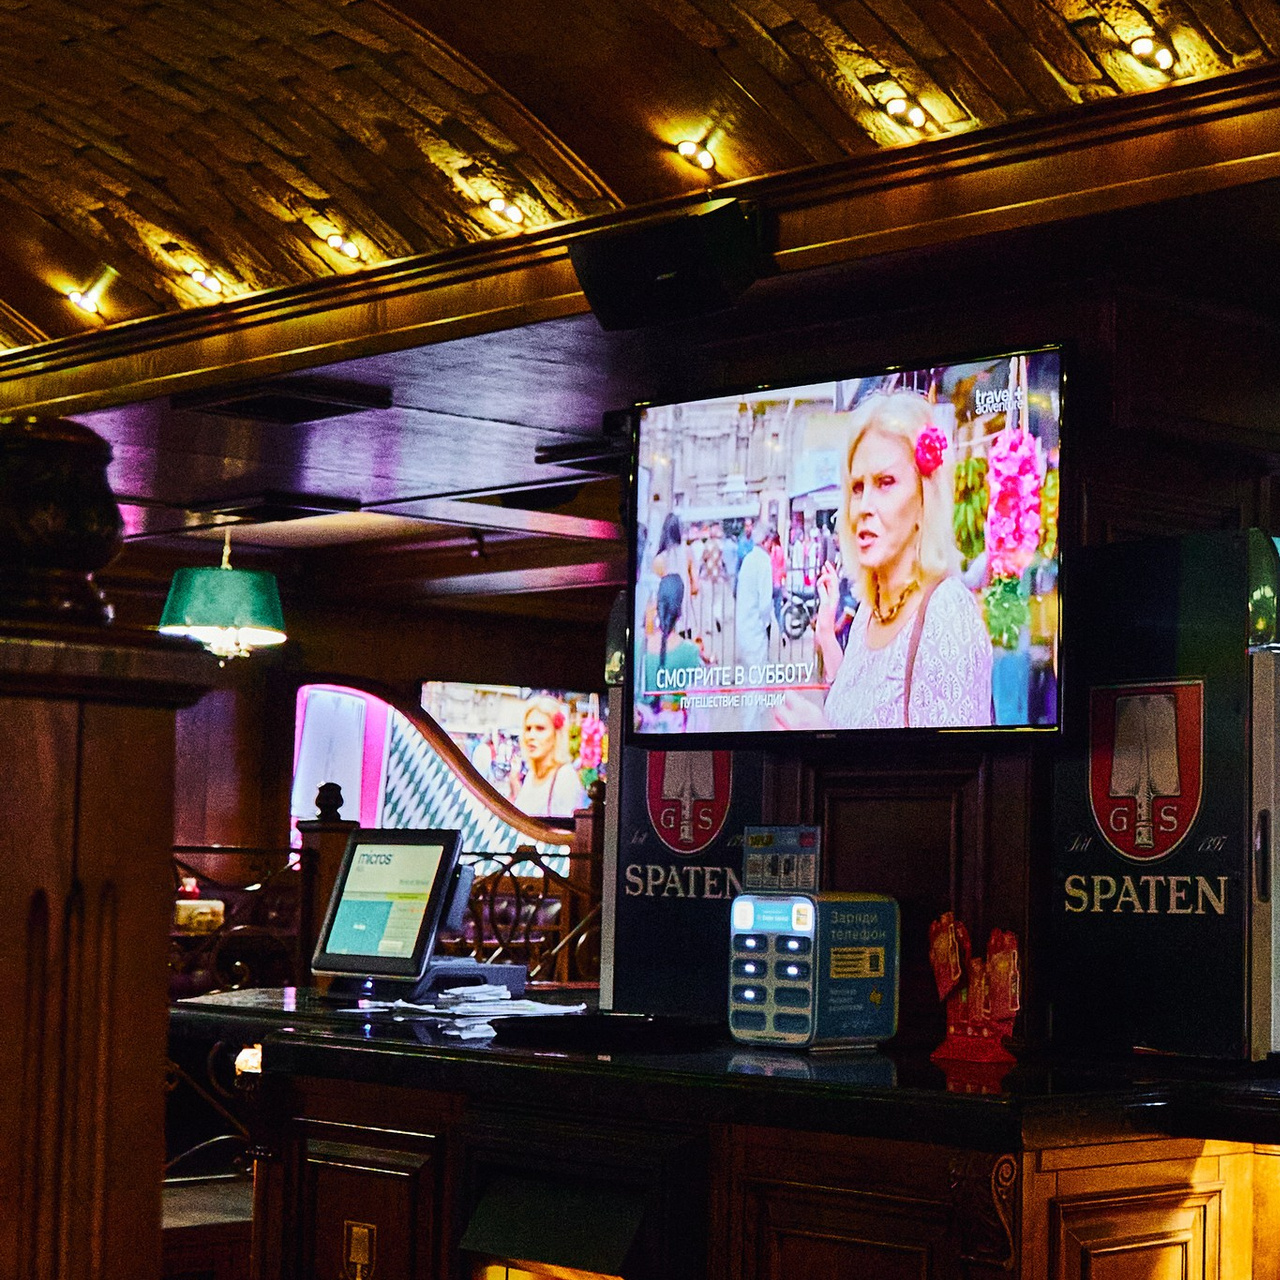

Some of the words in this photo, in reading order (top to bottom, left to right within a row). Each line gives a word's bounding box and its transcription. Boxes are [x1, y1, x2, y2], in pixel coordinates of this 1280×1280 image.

[975, 400, 1023, 415] adventure
[656, 666, 732, 689] СМОТРИТЕ
[735, 668, 745, 686] В
[748, 662, 814, 686] СУББОТУ
[680, 695, 741, 709] ПУТЕШЕСТВИЕ
[742, 695, 755, 707] ПО
[755, 694, 786, 707] ИНДИИ
[660, 807, 677, 829] G
[697, 807, 714, 831] S
[1109, 806, 1130, 833] G
[1158, 805, 1179, 833] S
[624, 863, 744, 900] SPATEN
[1064, 873, 1229, 916] SPATEN
[830, 910, 879, 926] Заряди
[830, 927, 887, 943] телефон
